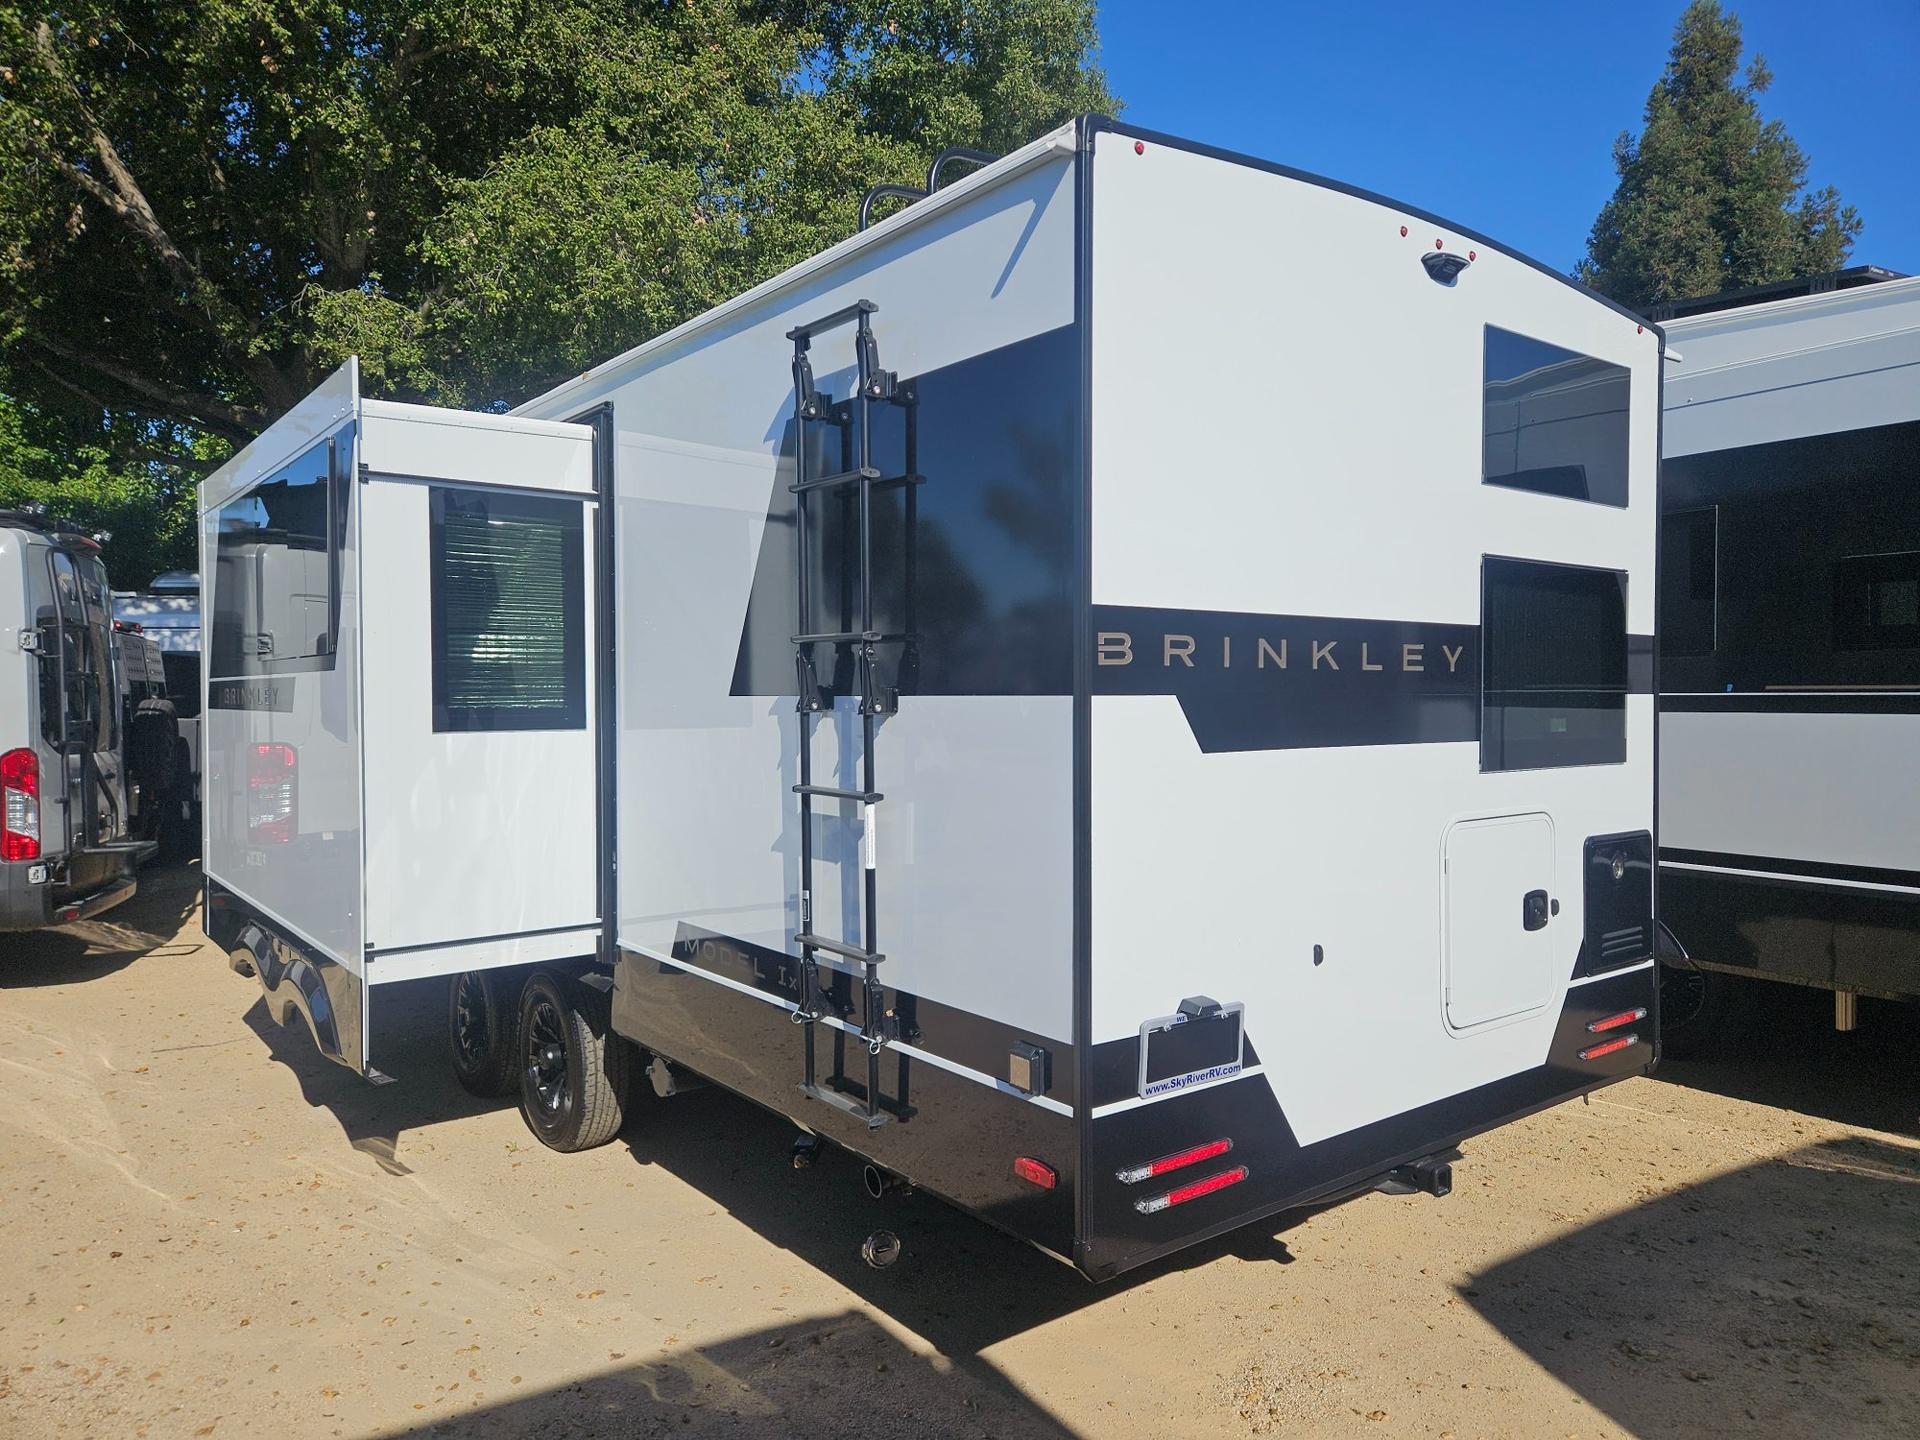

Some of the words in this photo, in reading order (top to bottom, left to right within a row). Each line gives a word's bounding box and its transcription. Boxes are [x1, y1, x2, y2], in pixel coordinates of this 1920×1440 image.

[1097, 632, 1464, 673] BRINKLEY
[683, 936, 766, 979] MODEL
[1145, 1064, 1242, 1096] www.SkyRiverRV.com
